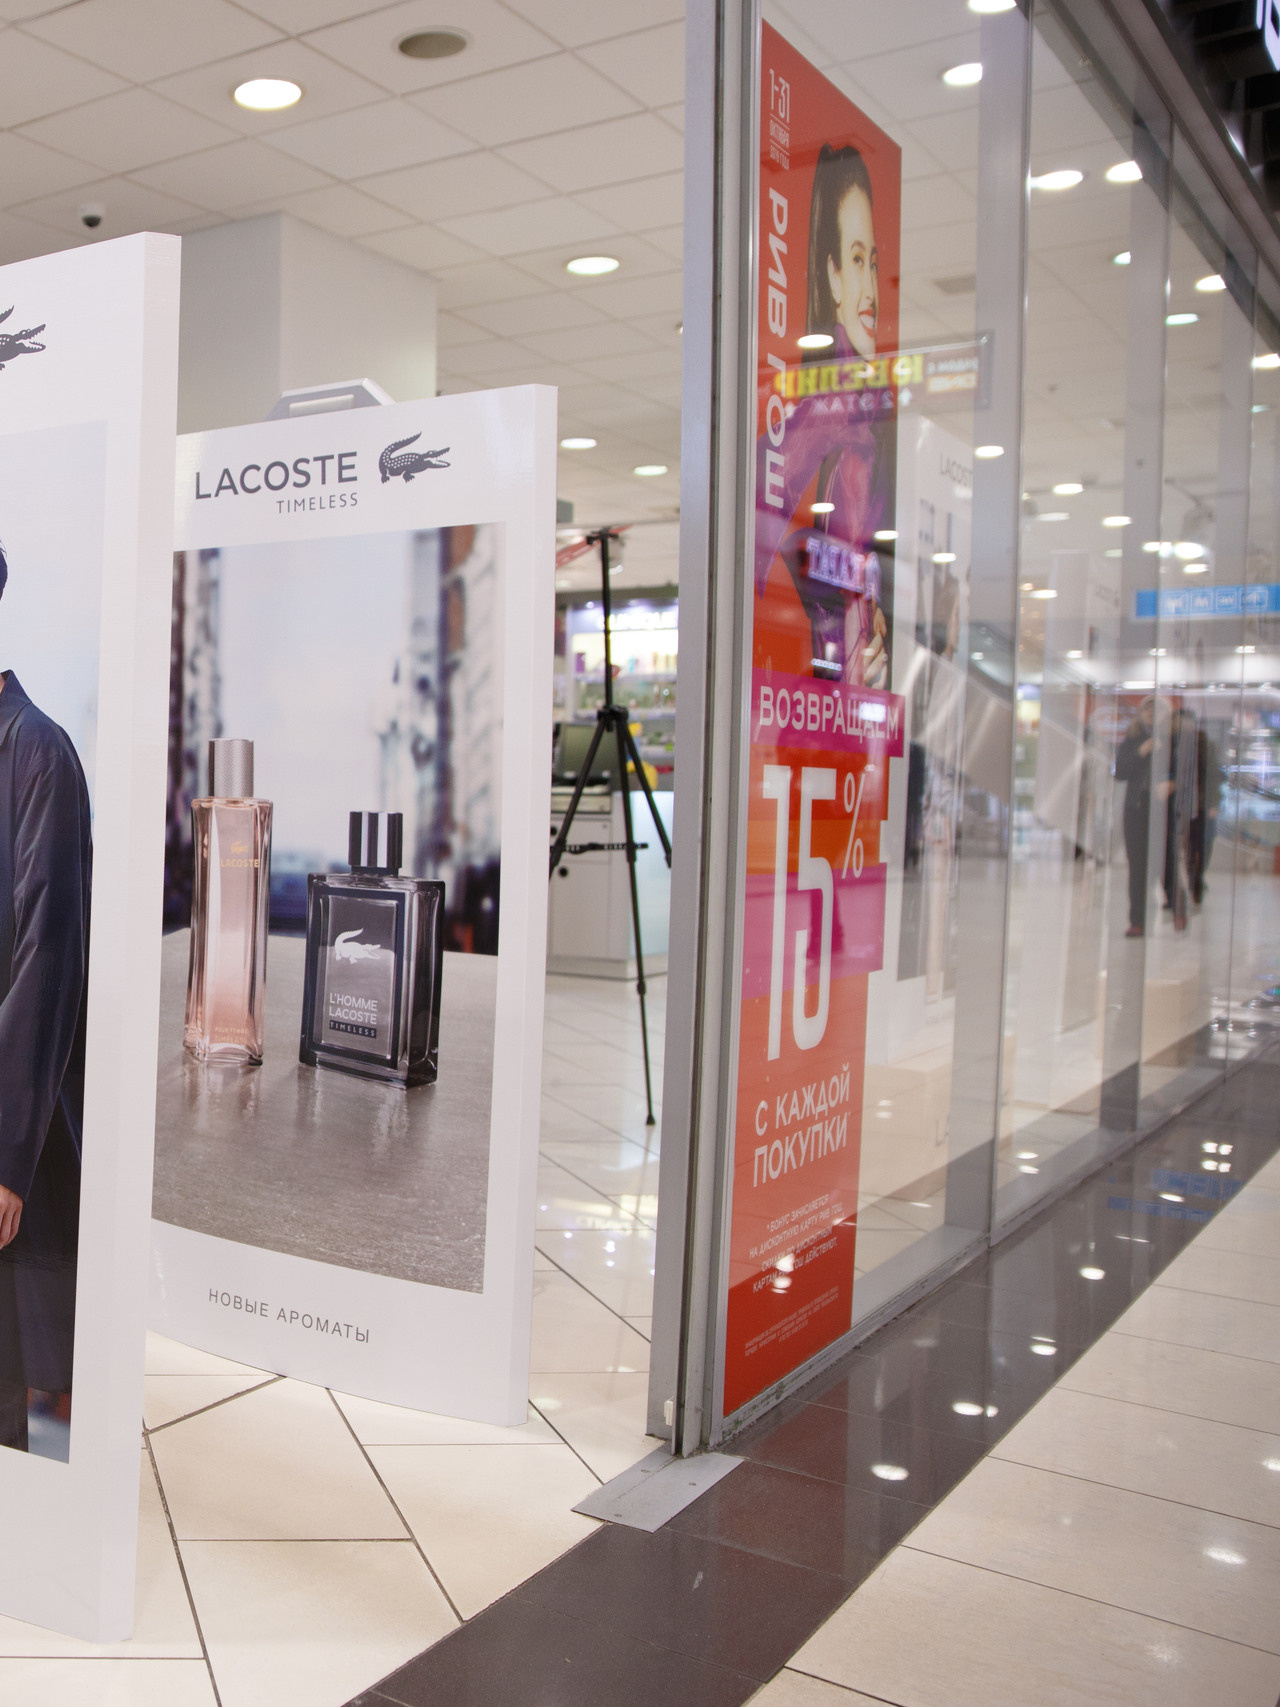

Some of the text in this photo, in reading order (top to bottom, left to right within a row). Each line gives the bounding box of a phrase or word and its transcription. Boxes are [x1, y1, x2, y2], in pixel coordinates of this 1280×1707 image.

[770, 68, 790, 123] 1-31
[768, 187, 788, 338] РИВ
[195, 451, 358, 500] LACOSTE
[276, 491, 358, 515] TIMELESS
[220, 858, 260, 869] LACOSTE
[328, 1005, 378, 1025] LACOSTE
[329, 992, 378, 1012] L'HOMME
[329, 1021, 376, 1038] TIMELESS
[755, 1062, 851, 1137] С КАЖДОЙ
[749, 1246, 758, 1260] НА
[758, 1224, 799, 1257] ДИСКОНТНУЮ
[800, 1213, 818, 1232] КАРТУ
[208, 1288, 370, 1344] НОВЫЕ АРОМАТЫ
